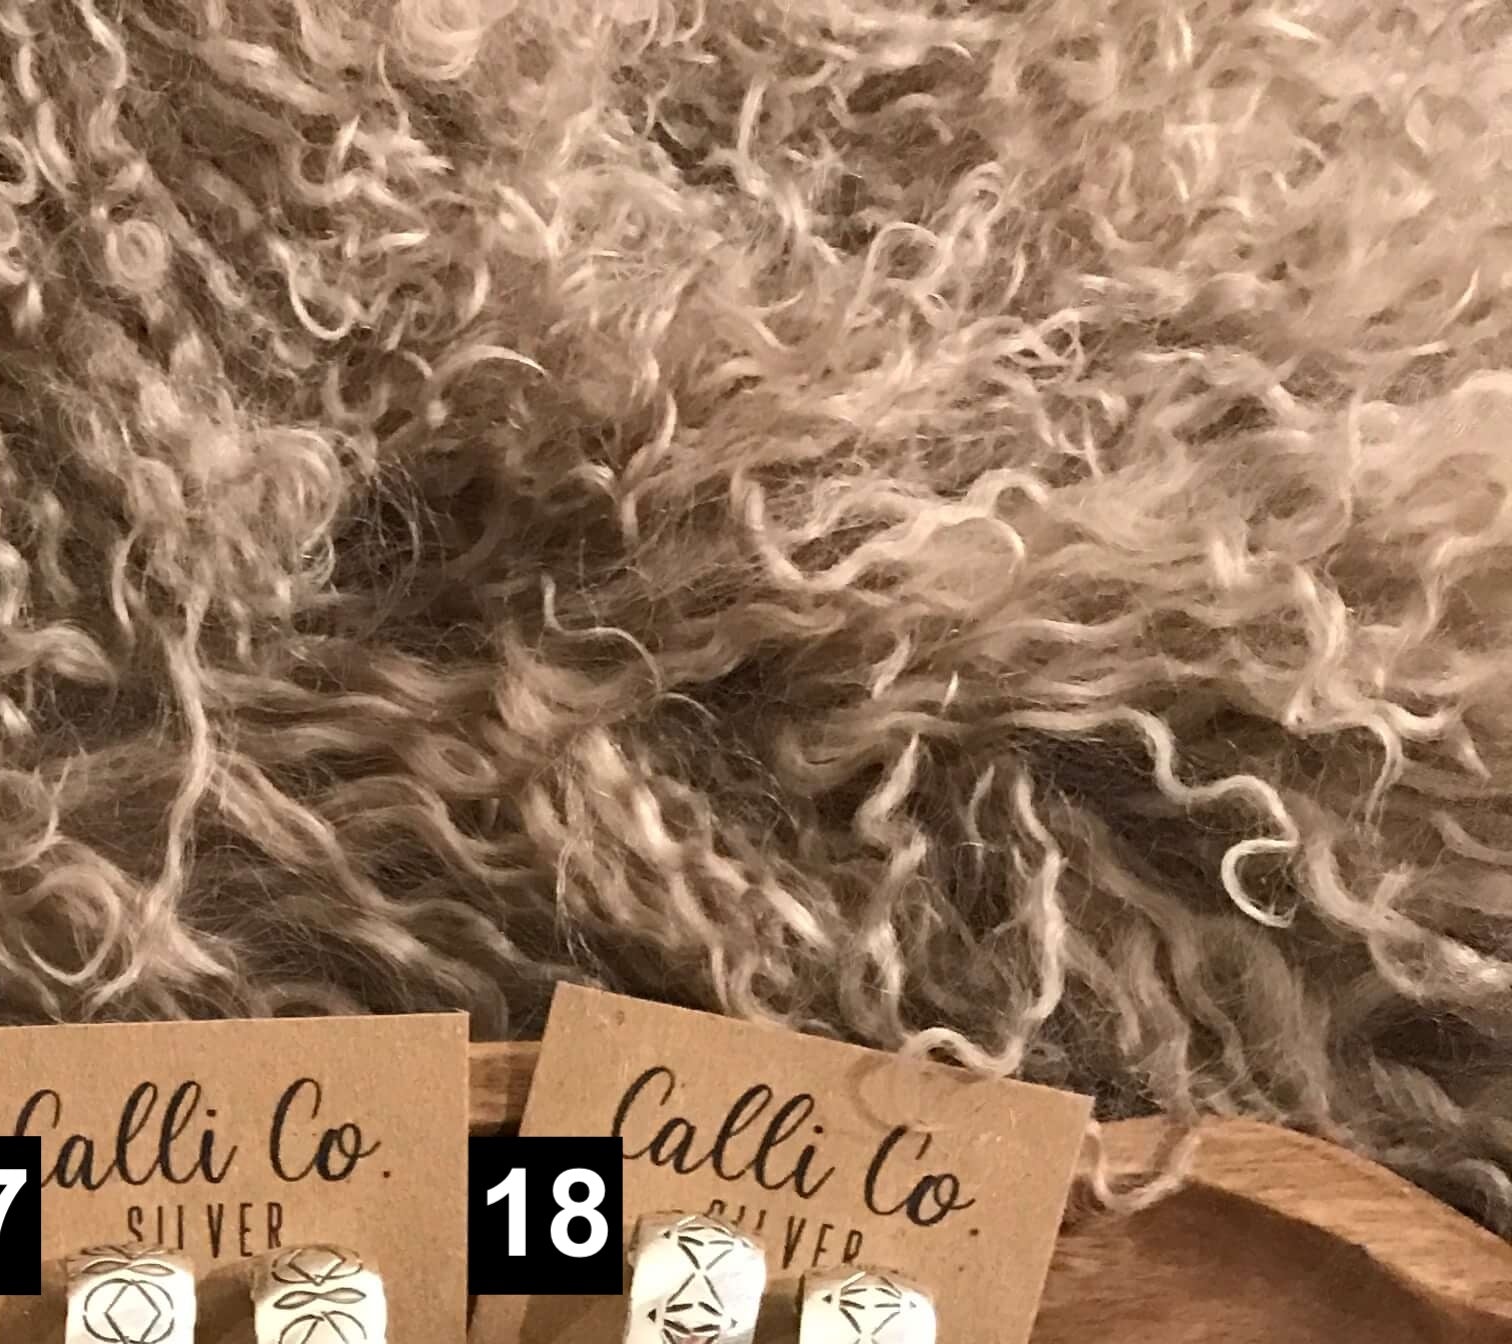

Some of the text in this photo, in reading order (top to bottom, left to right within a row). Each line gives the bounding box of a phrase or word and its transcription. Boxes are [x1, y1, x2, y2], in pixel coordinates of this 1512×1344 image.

[269, 1077, 390, 1183] Co.
[611, 1066, 981, 1236] Calli Co.
[128, 1202, 282, 1258] SILVER
